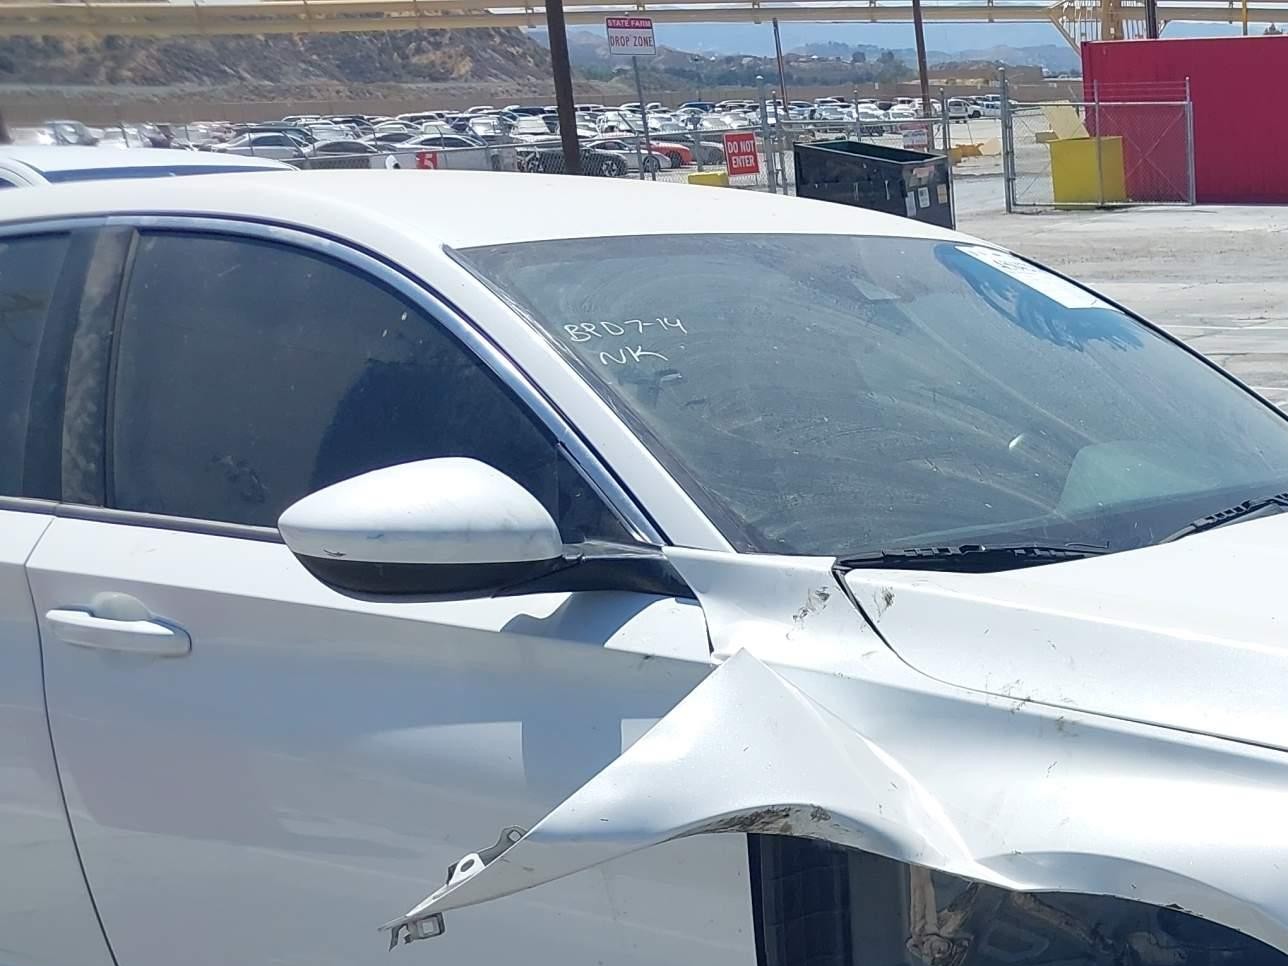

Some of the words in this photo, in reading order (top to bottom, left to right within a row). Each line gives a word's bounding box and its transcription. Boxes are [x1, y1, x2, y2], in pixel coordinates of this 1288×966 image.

[610, 36, 630, 47] DROP
[633, 36, 653, 47] ZONE
[728, 141, 739, 153] DO
[740, 140, 754, 152] NOT
[732, 155, 755, 168] ENTER
[600, 345, 669, 365] NK
